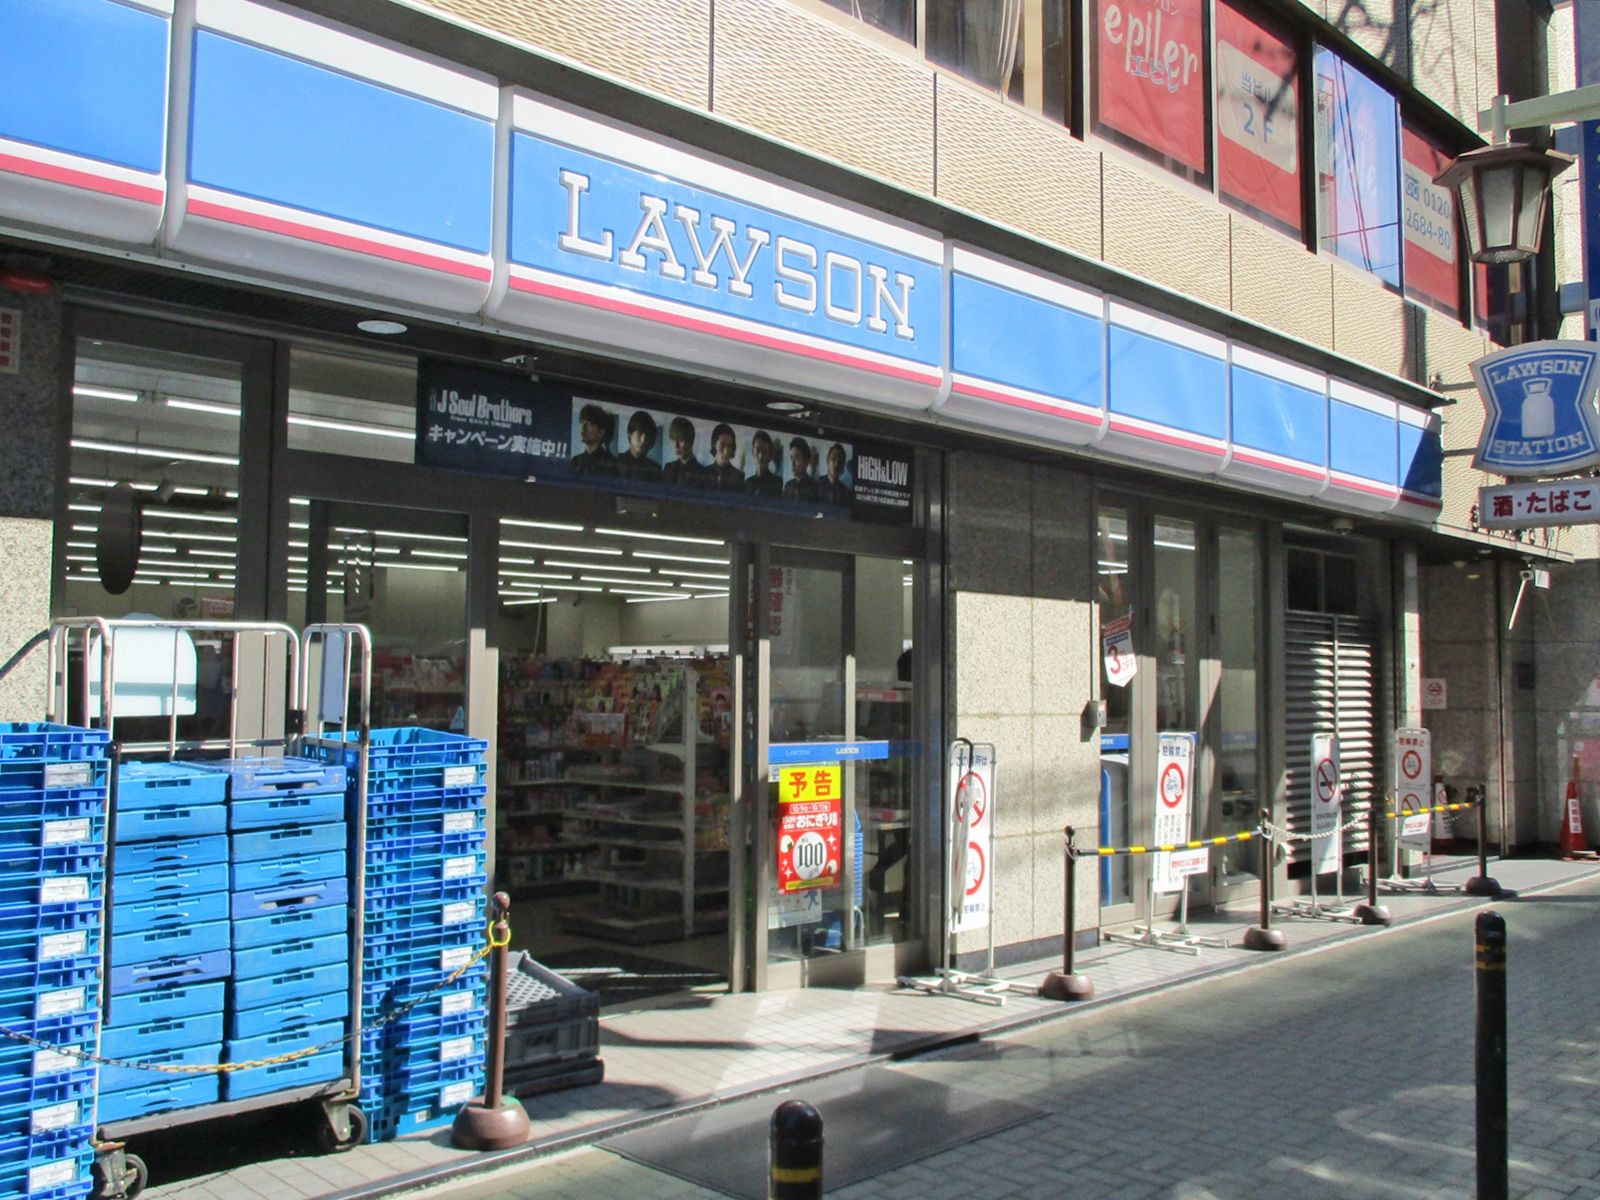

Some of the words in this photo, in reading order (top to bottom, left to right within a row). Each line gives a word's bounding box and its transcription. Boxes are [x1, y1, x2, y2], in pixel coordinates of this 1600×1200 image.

[1105, 4, 1199, 86] epiler
[1241, 70, 1272, 104] 当ビル
[1423, 187, 1450, 220] 0120
[558, 168, 915, 341] LAWSON
[1491, 359, 1584, 385] LAWSON
[448, 390, 476, 417] Soul
[477, 395, 533, 426] Brothers
[1493, 431, 1586, 455] STATION
[788, 770, 833, 798] 予告
[796, 842, 824, 869] 100
